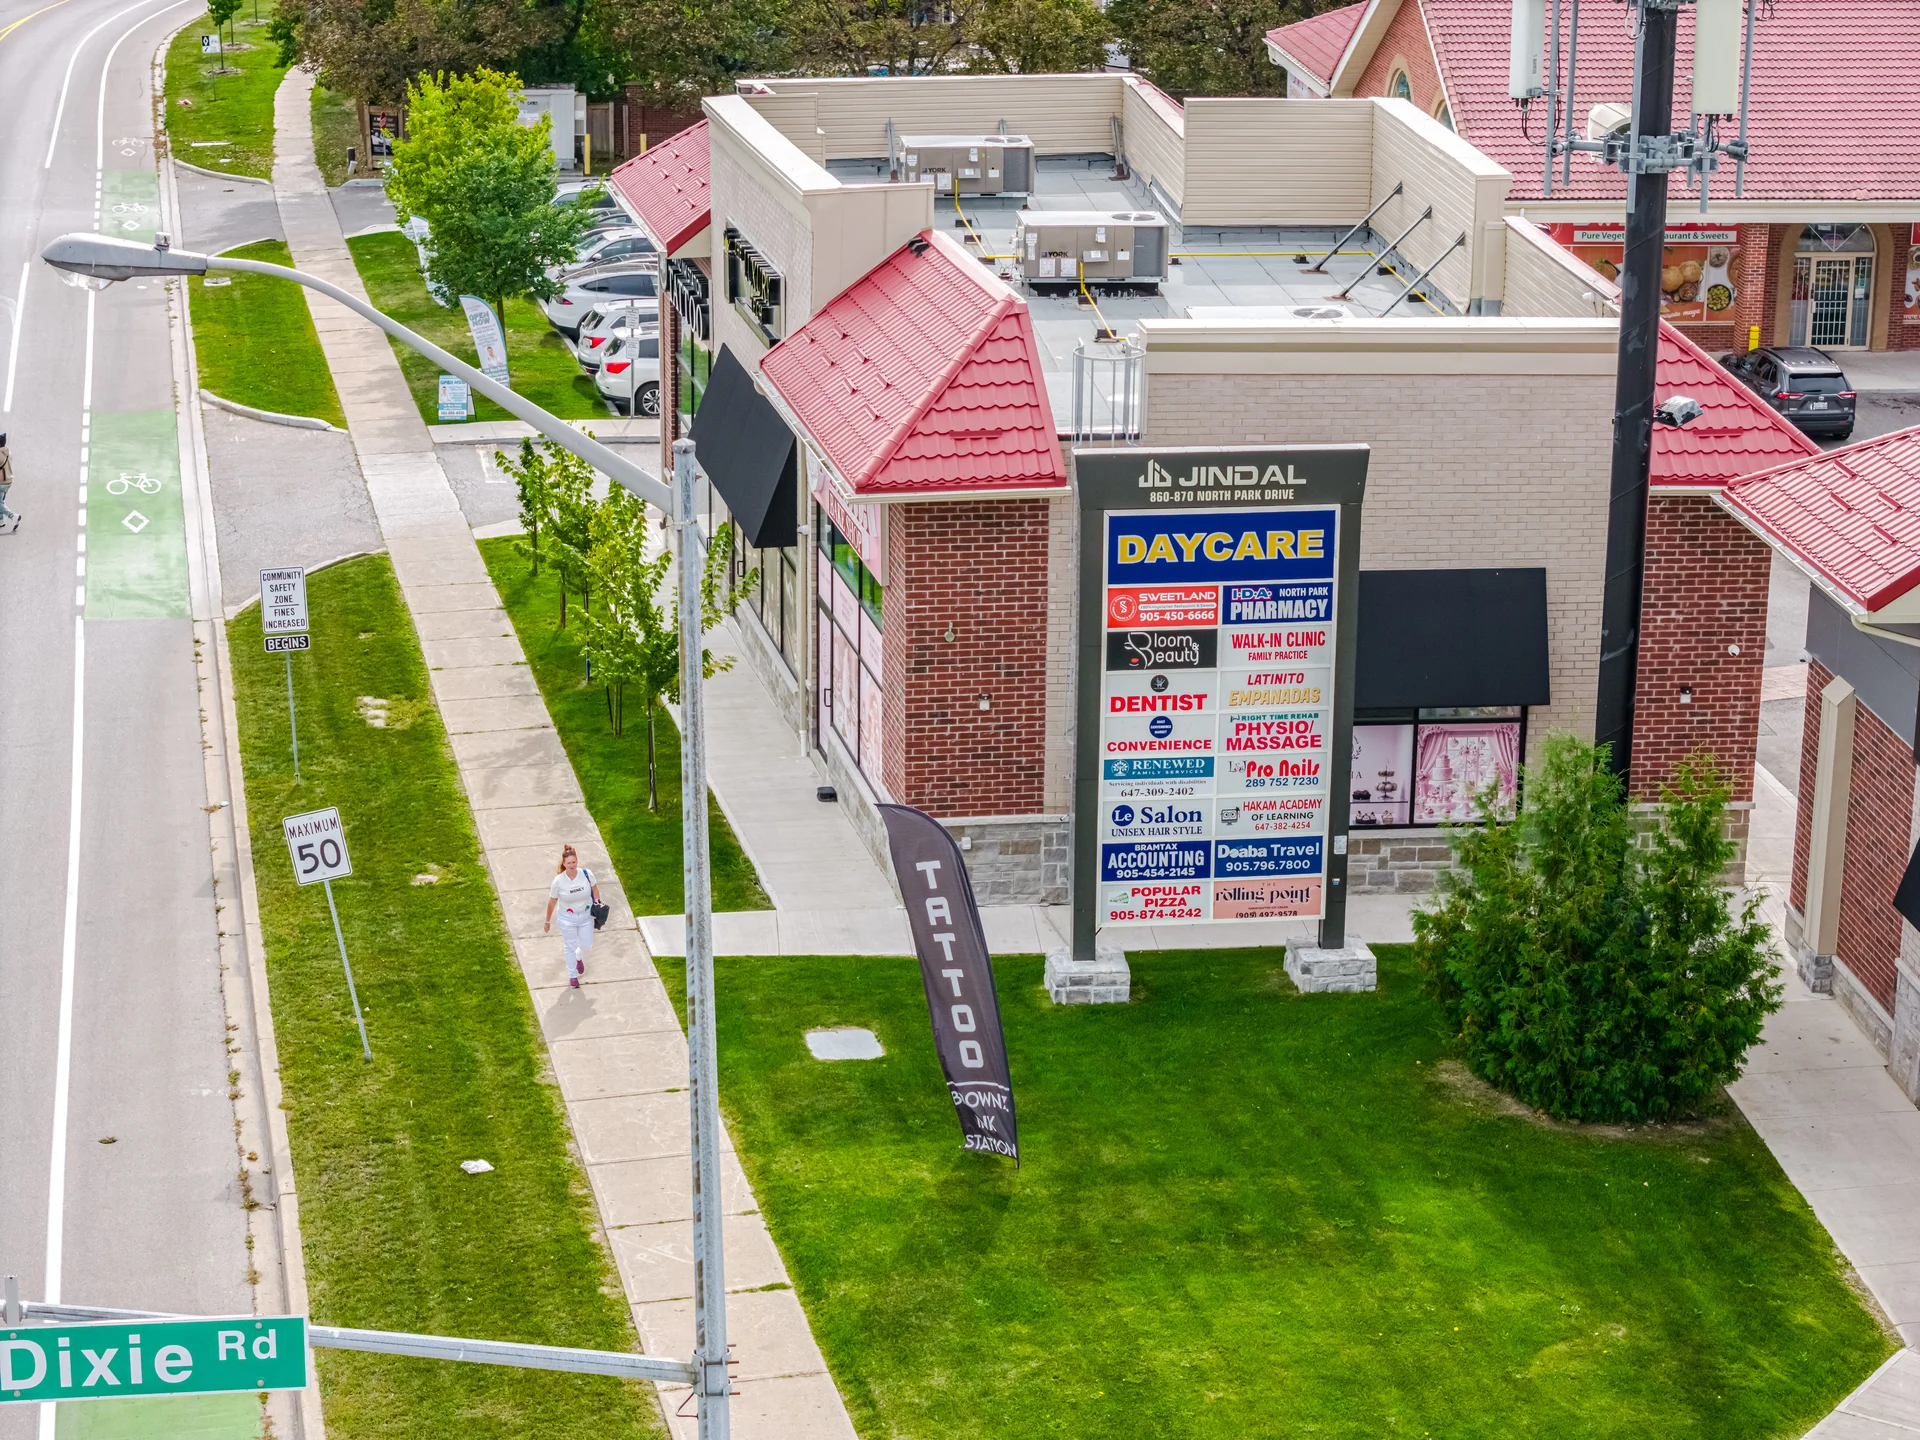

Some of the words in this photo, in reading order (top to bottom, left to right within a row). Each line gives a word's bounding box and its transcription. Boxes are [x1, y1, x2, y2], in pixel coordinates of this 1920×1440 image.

[1581, 231, 1600, 240] Pure
[1692, 231, 1699, 240] &
[1700, 231, 1729, 240] Sweets
[469, 311, 489, 321] OPEN
[472, 317, 490, 327] NOW
[1178, 465, 1307, 486] JINDAL
[1149, 491, 1194, 503] 860-870
[1196, 490, 1232, 502] NORTH
[1234, 489, 1262, 501] PARK
[1264, 488, 1294, 500] DRIVE
[1117, 529, 1325, 565] DAYCARE
[262, 571, 301, 582] COMMUNITY
[269, 583, 296, 592] SAFETY
[1279, 588, 1306, 597] NORTH
[1308, 587, 1328, 596] PARK
[274, 594, 293, 604] ZONE
[1138, 591, 1217, 602] SWEETLAND
[273, 607, 296, 617] FINES
[1230, 599, 1328, 620] PHARMACY
[1139, 611, 1215, 622] 905-450-6666
[265, 618, 306, 629] INCREASED
[267, 637, 307, 650] BEGINS
[1231, 632, 1283, 649] WALK-IN
[1286, 631, 1326, 647] CLINIC
[1248, 651, 1272, 661] FAMILY
[1274, 650, 1308, 660] PRACTICE
[1247, 673, 1304, 685] LATINITO
[1110, 694, 1207, 713] DENTIST
[1229, 688, 1321, 706] EMPANADAS
[1235, 720, 1314, 736] PHYSIO/
[1107, 739, 1212, 752] CONVENIENCE
[1226, 735, 1322, 751] MASSAGE
[1132, 758, 1205, 770] RENEWED
[1246, 761, 1274, 778] Pro
[1279, 758, 1320, 777] Nails
[1245, 778, 1266, 788] 289
[1267, 777, 1289, 787] 752
[1292, 776, 1319, 786] 7230
[1121, 787, 1194, 798] 647-309-2402
[1243, 800, 1277, 811] HAKAM
[1279, 798, 1323, 810] ACADEMY
[1113, 808, 1133, 823] Le
[1141, 805, 1203, 824] Salon
[1251, 813, 1264, 821] OF
[1266, 811, 1314, 820] LEARNING
[288, 818, 339, 840] MAXIMUM
[1111, 827, 1146, 837] UNISEX
[1148, 827, 1171, 836] HAIR
[1173, 826, 1203, 835] STYLE
[1254, 821, 1311, 831] 647-382-4254
[1134, 843, 1178, 851] BRAMTAX
[1270, 842, 1320, 857] Travel
[297, 838, 342, 875] 50
[1108, 850, 1205, 869] ACCOUNTING
[1225, 859, 1311, 872] 905.796.7800
[1116, 867, 1195, 878] 905-454-2145
[1131, 885, 1201, 898] POPULAR
[1269, 885, 1311, 904] point
[1144, 897, 1187, 908] PIZZA
[1110, 907, 1202, 920] 905-874-4242
[915, 860, 985, 1070] TATTOO
[964, 1134, 1018, 1159] STATION
[0, 1333, 193, 1391] Dixie
[218, 1329, 277, 1361] Rd
